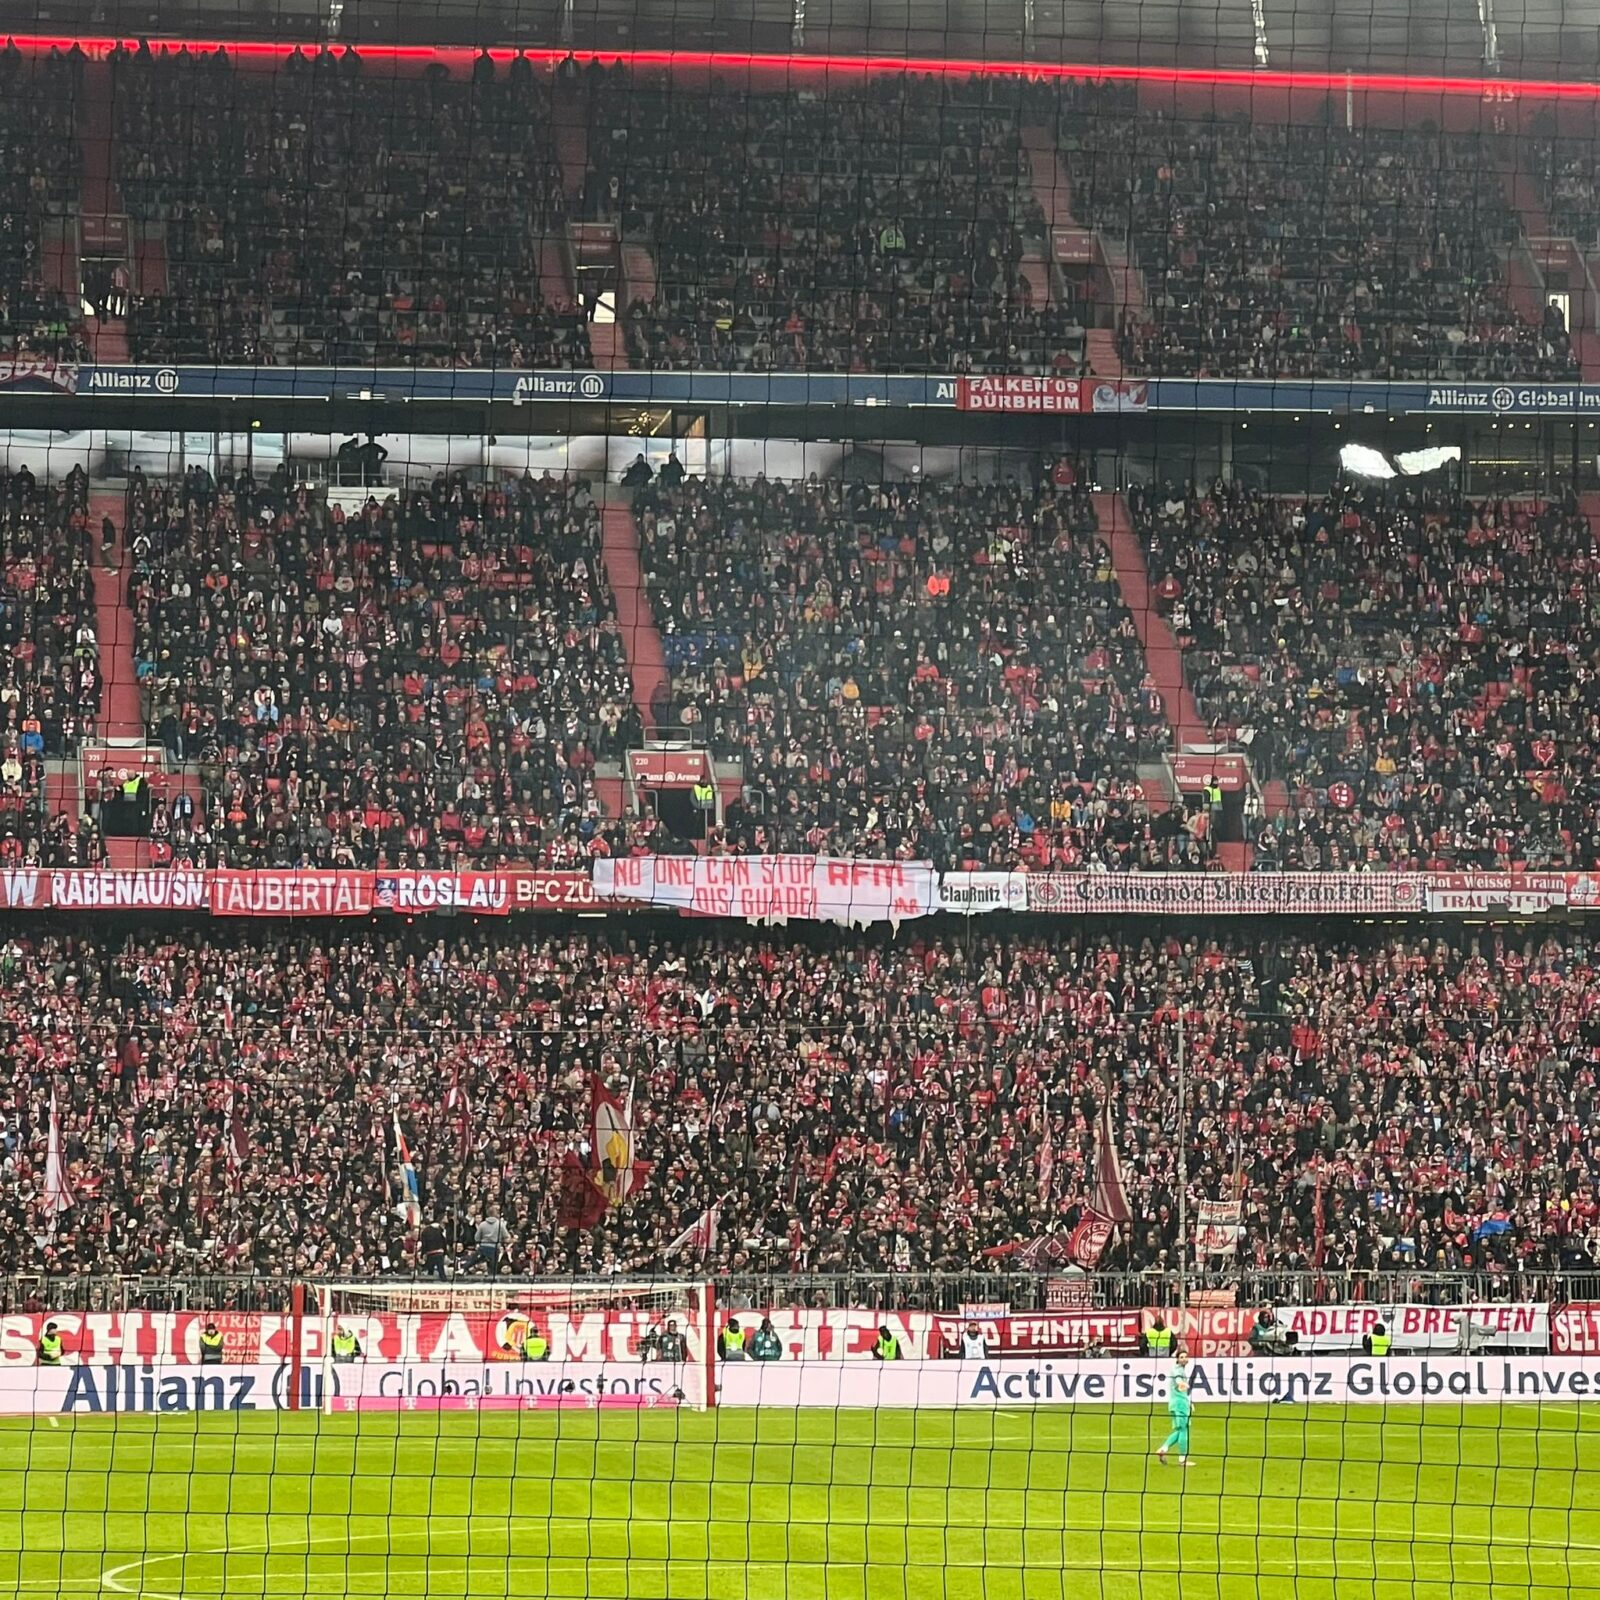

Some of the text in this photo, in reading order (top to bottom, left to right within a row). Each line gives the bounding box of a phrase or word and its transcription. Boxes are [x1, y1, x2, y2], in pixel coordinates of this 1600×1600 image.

[89, 372, 151, 389] Allianz
[515, 377, 575, 393] Allianz
[970, 392, 1080, 410] DÜRBHEIM
[1429, 389, 1488, 406] Allianz
[1518, 390, 1573, 407] Global
[1215, 776, 1238, 784] rena
[615, 857, 641, 887] NO
[654, 857, 693, 885] ONE
[706, 857, 749, 885] CAN
[761, 853, 815, 884] STOP
[216, 876, 371, 911] TAUBERTAL
[399, 877, 508, 908] RÖSLAU
[516, 878, 561, 902] BFC
[939, 886, 1001, 903] Claußnitz
[938, 1321, 1001, 1346] RD
[1291, 1310, 1379, 1335] ADLER
[61, 1364, 256, 1413] Allianz
[970, 1364, 1106, 1399] Active
[1123, 1363, 1167, 1397] is:
[1187, 1362, 1333, 1397] Allianz
[1347, 1361, 1488, 1396] Global
